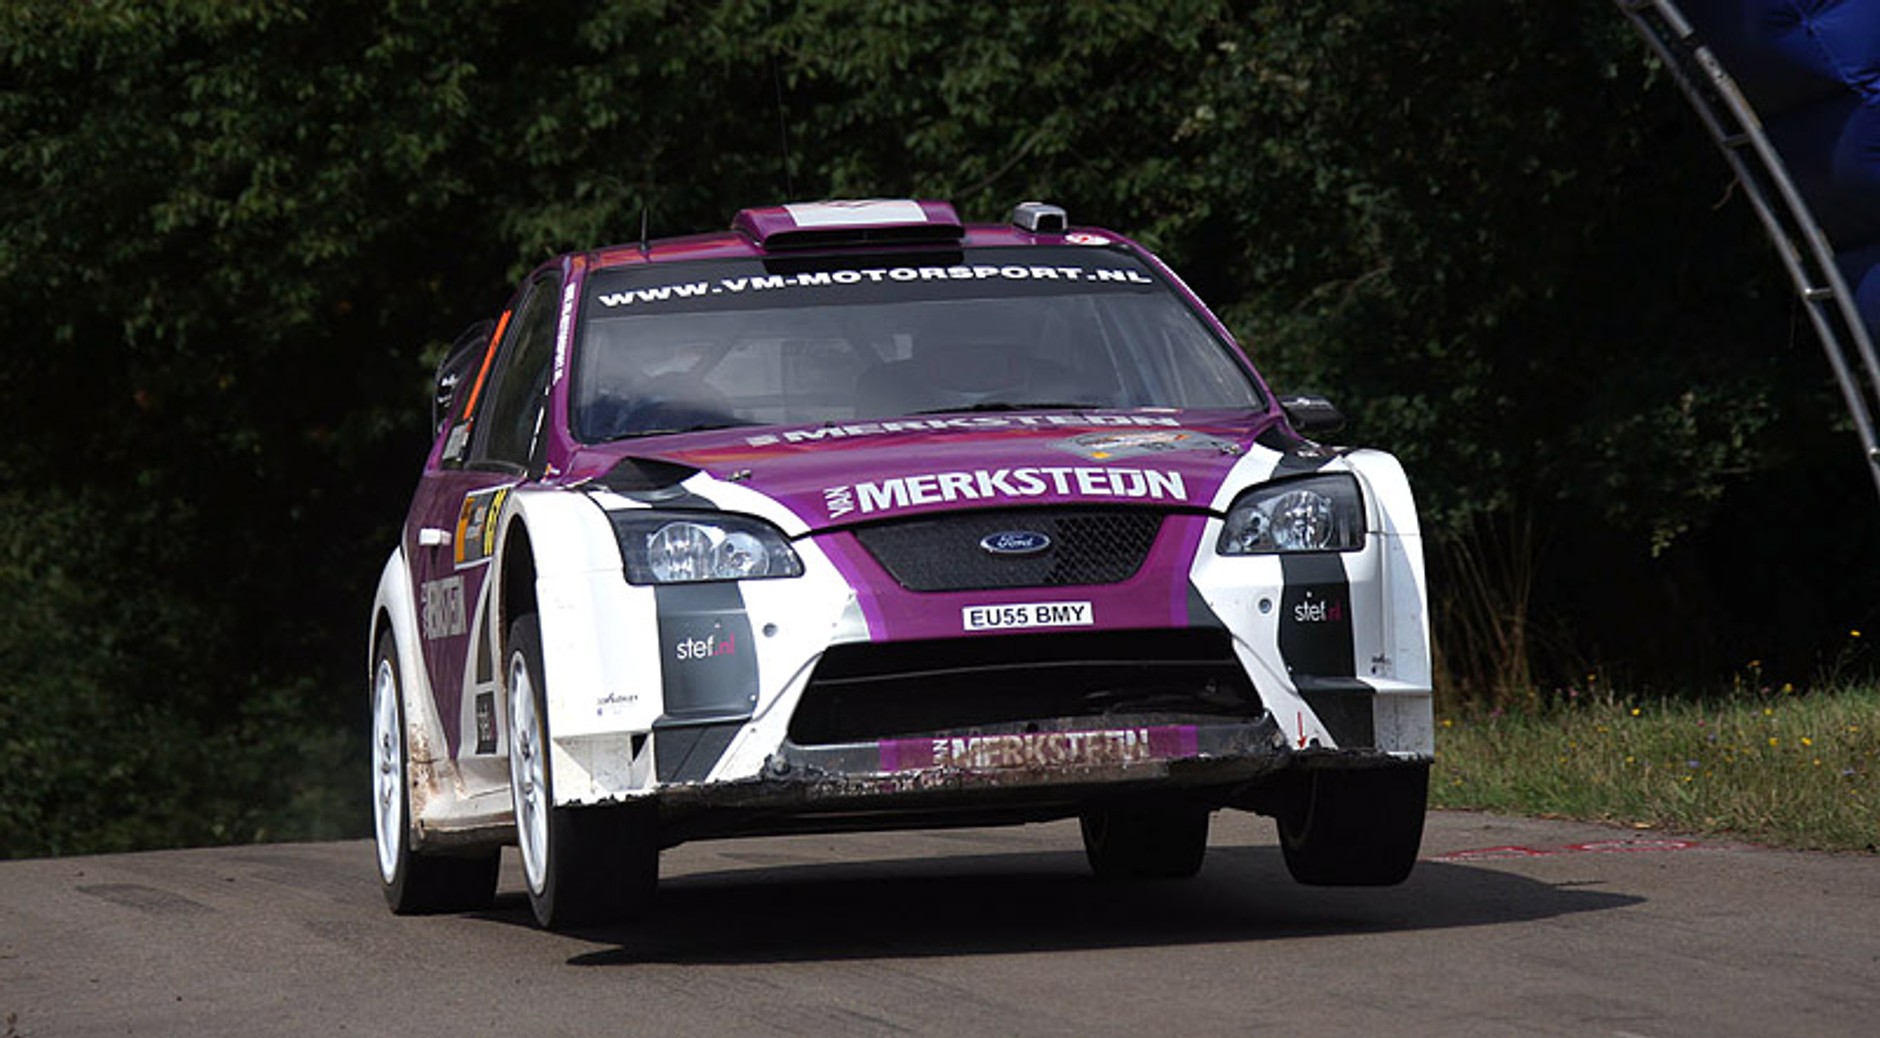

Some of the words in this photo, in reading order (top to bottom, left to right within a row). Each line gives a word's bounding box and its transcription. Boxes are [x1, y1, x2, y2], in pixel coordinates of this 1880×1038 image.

[599, 266, 1152, 307] WWW.VM-MOTORSPORT.NL
[823, 485, 854, 519] VAN
[998, 533, 1034, 549] Ford
[970, 607, 1029, 627] EU55
[1036, 605, 1085, 624] BMY
[676, 632, 736, 660] stef.nl
